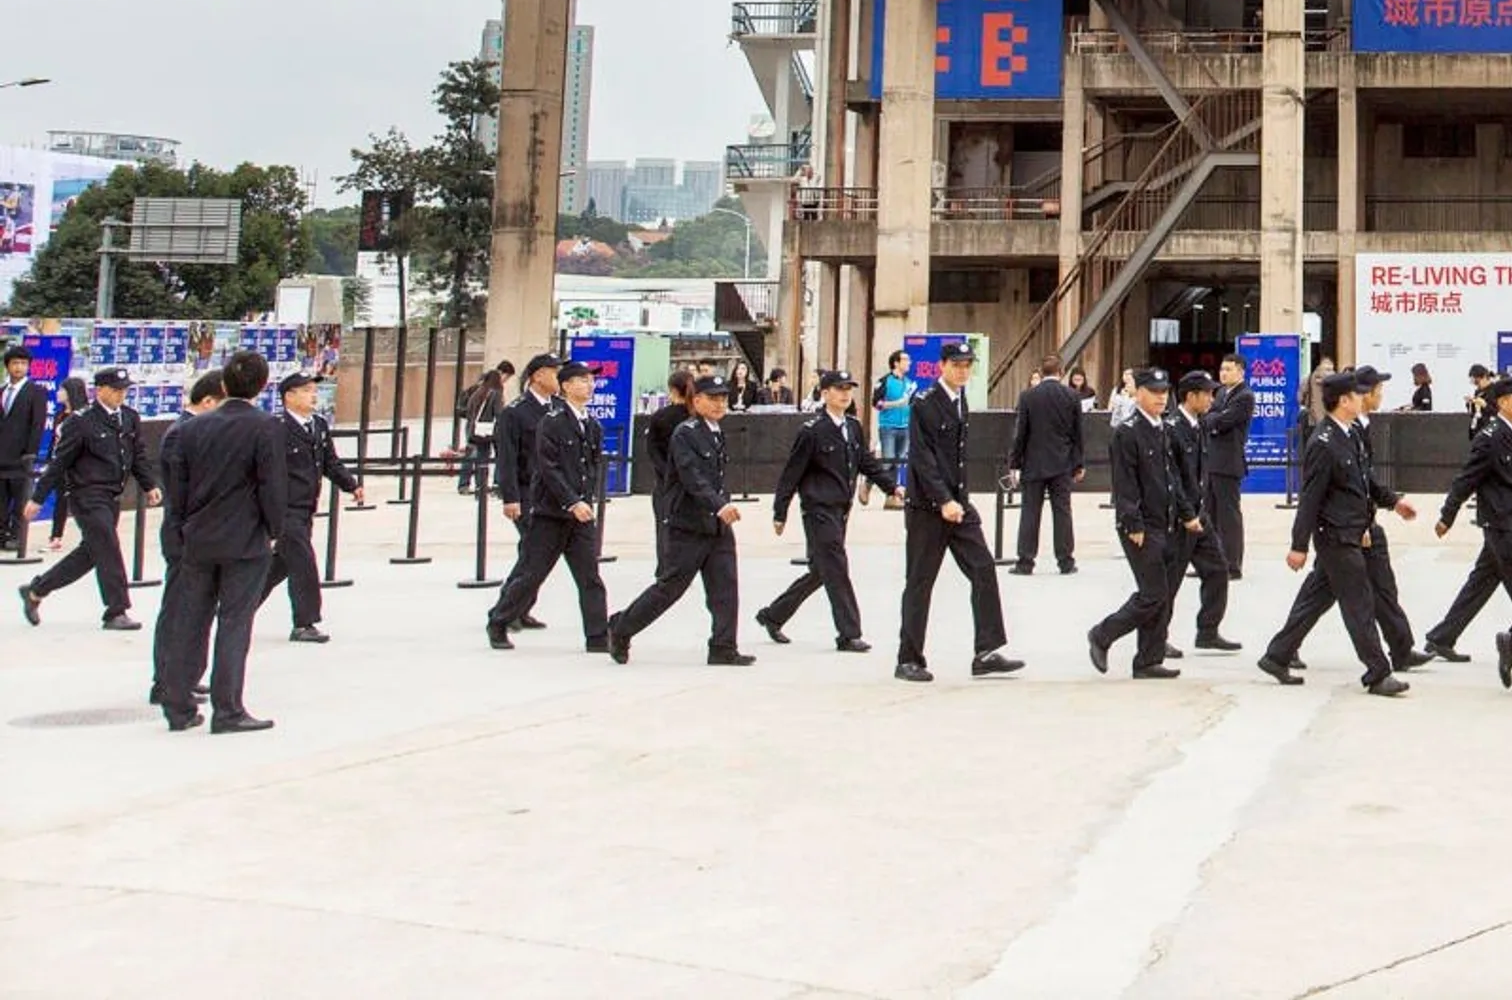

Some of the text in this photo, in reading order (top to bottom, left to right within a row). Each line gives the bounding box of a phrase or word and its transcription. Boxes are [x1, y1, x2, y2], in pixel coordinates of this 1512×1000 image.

[1371, 265, 1487, 286] RE-LIVING
[1370, 291, 1462, 314] 城市原点
[1251, 358, 1286, 376] 公众
[1250, 376, 1287, 387] PUBLIC
[1252, 405, 1285, 418] SIGN
